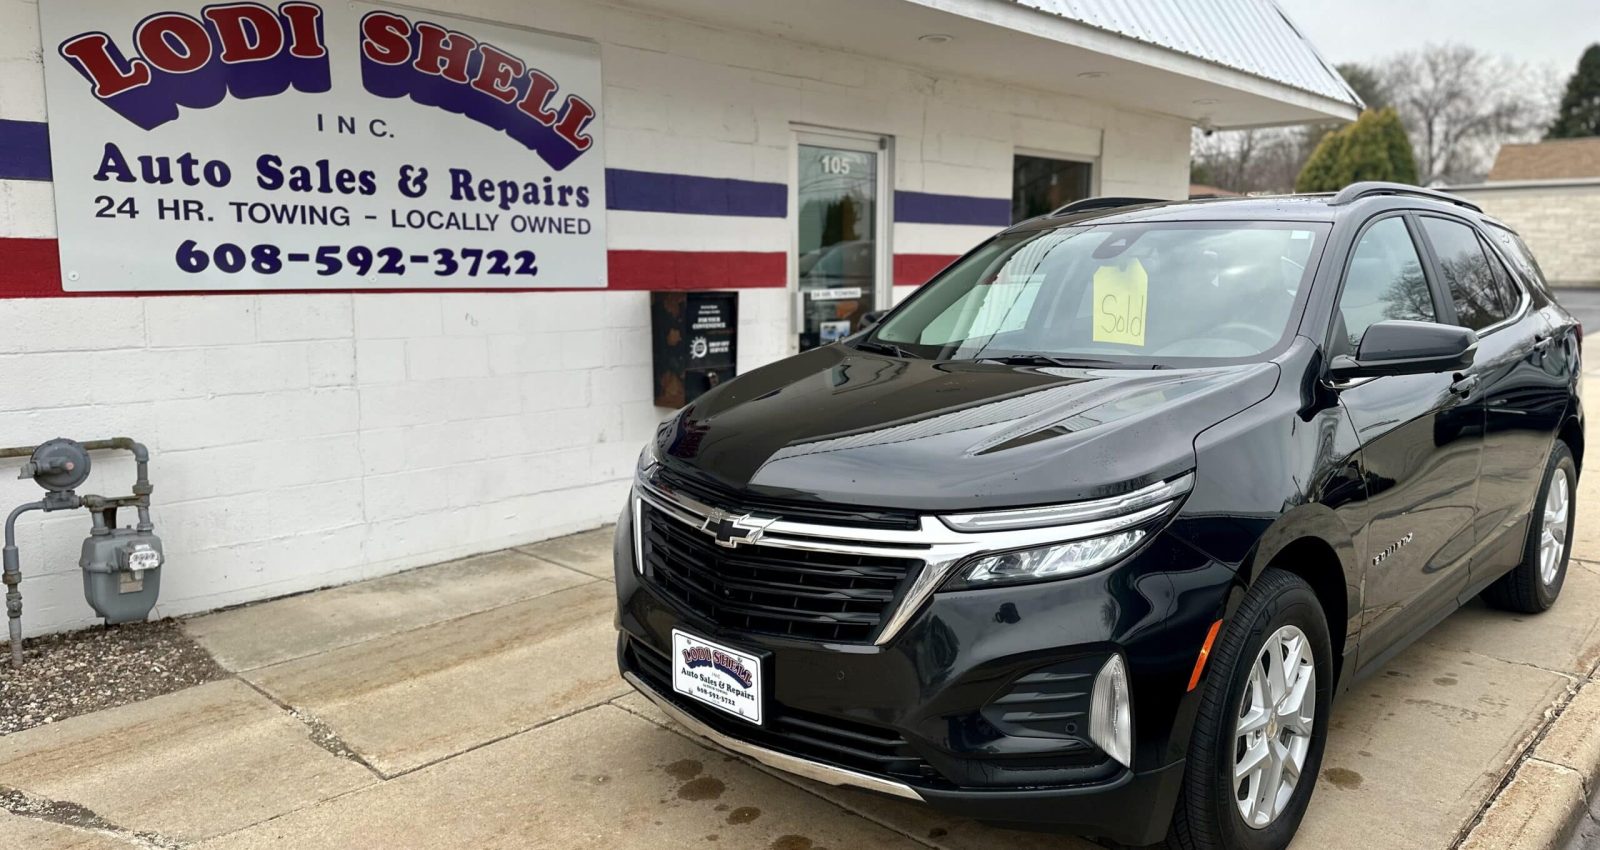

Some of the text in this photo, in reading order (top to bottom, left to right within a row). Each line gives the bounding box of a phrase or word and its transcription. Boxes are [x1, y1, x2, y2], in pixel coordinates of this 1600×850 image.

[59, 0, 595, 156] LODI SHELL
[316, 113, 395, 139] INC.
[93, 142, 590, 211] Auto Sales & Repairs
[822, 155, 850, 174] 105
[94, 195, 139, 219] 24
[157, 198, 214, 222] HR.
[229, 201, 350, 227] TOWING
[391, 209, 500, 232] LOCALLY
[510, 214, 592, 235] OWNED
[175, 239, 538, 277] 608-592-3722
[1100, 293, 1144, 337] Sold
[681, 667, 755, 701] Auto Sales & Repairs
[682, 646, 752, 688] LODI SHELL
[696, 686, 736, 706] 608-592-3722
